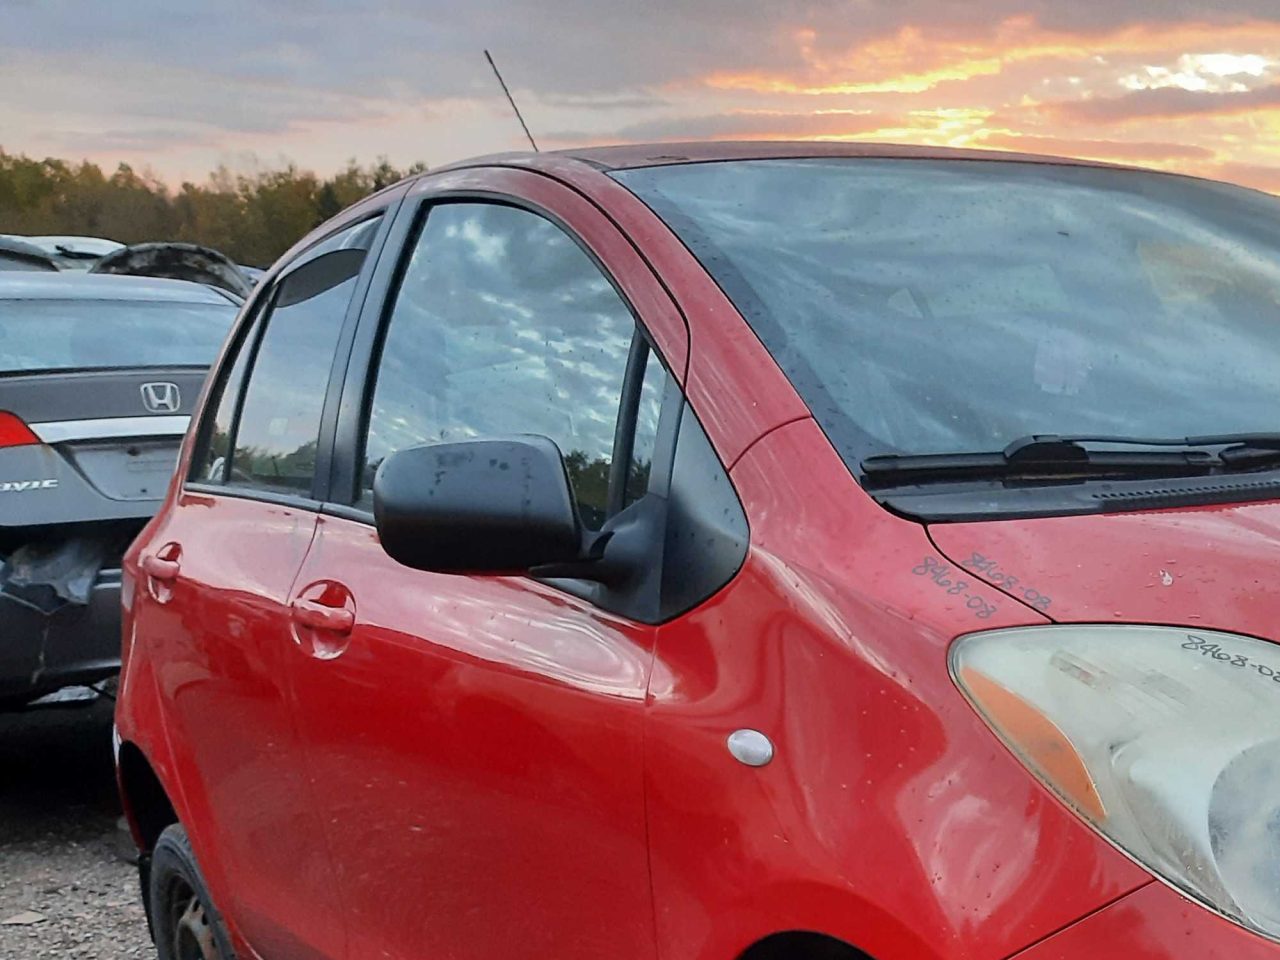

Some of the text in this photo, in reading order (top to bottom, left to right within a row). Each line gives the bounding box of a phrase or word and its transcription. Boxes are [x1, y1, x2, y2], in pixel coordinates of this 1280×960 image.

[0, 480, 58, 490] IVIC
[912, 556, 997, 619] 8468-08
[962, 552, 1051, 610] 8468-08
